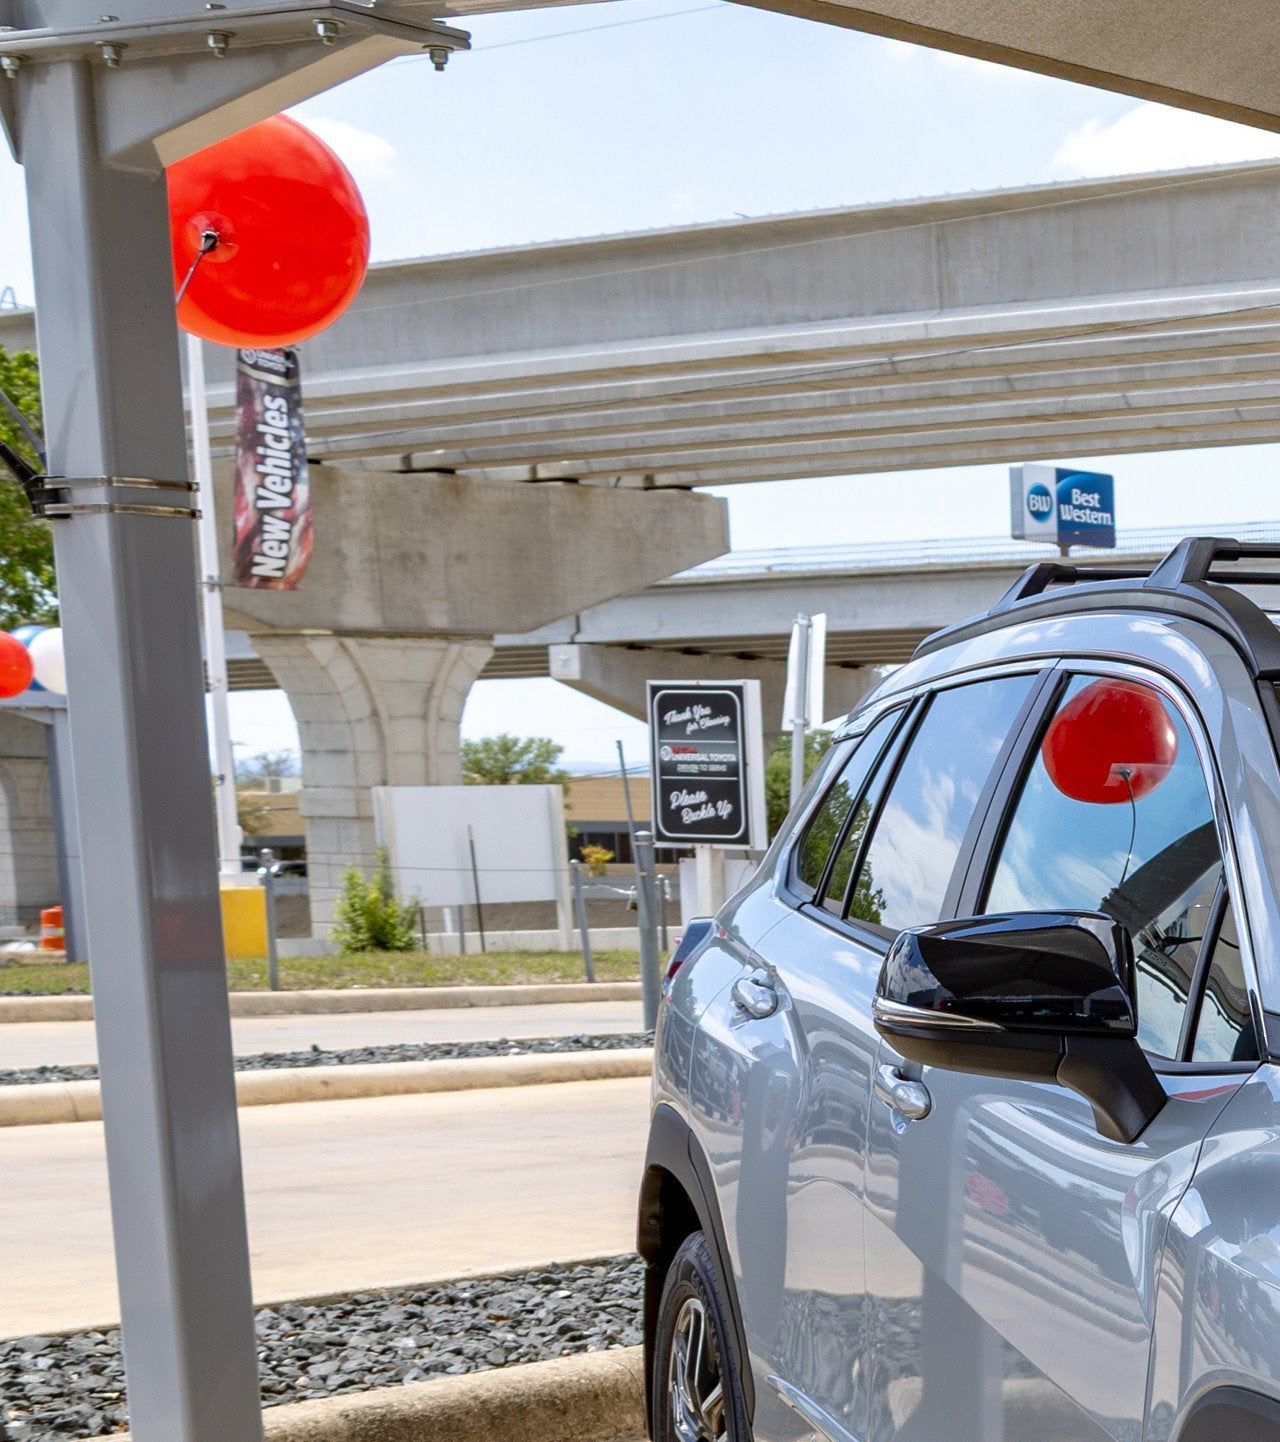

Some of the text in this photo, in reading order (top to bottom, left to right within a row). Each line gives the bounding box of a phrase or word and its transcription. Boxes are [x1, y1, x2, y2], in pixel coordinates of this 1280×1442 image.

[256, 394, 293, 509] Vehicles
[1029, 494, 1051, 513] BW
[1071, 488, 1100, 508] Best
[1060, 503, 1113, 526] Western
[252, 515, 291, 578] New
[663, 705, 712, 726] Thank You
[671, 753, 736, 762] UNIVERSAL TOYOTA
[669, 789, 708, 810] Please
[681, 800, 733, 825] Buckle Up
